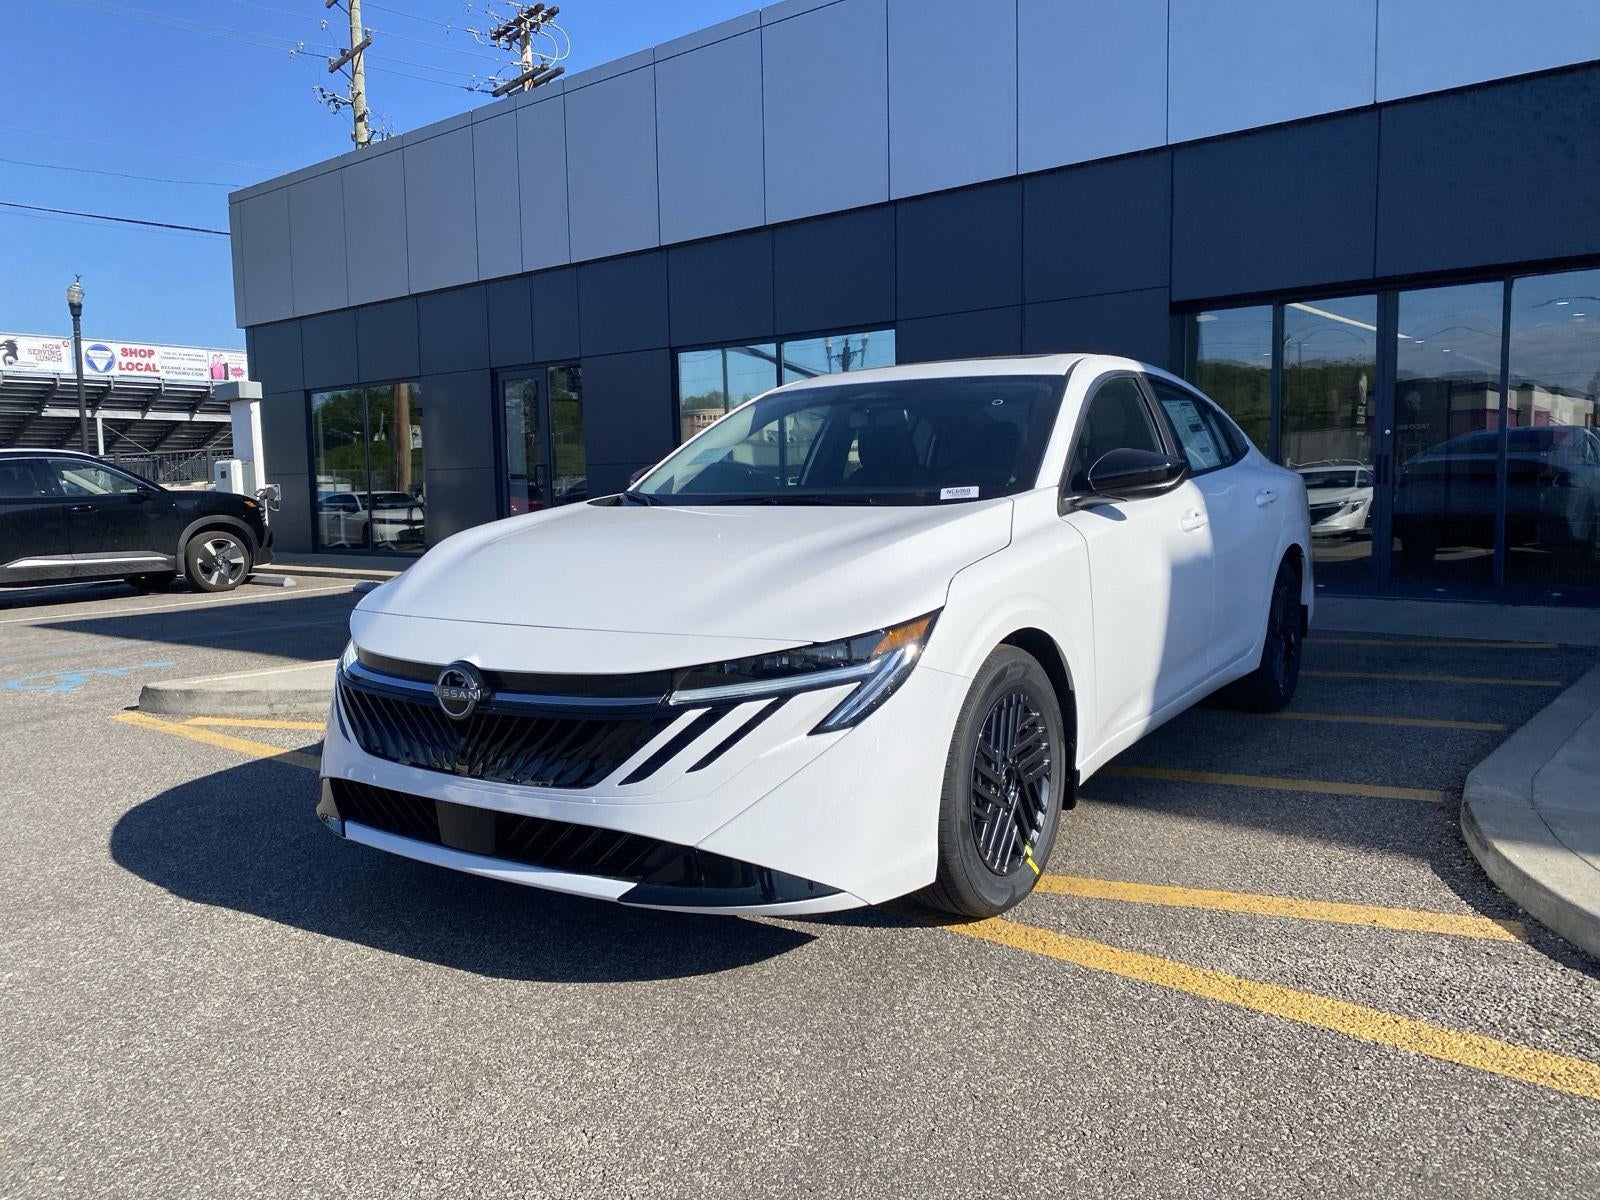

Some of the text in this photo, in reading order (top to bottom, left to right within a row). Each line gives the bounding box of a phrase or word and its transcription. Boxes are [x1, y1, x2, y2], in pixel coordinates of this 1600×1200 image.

[27, 349, 62, 357] SERVING
[120, 347, 155, 358] SHOP
[118, 361, 160, 372] LOCAL
[434, 686, 477, 699] NISSAN
